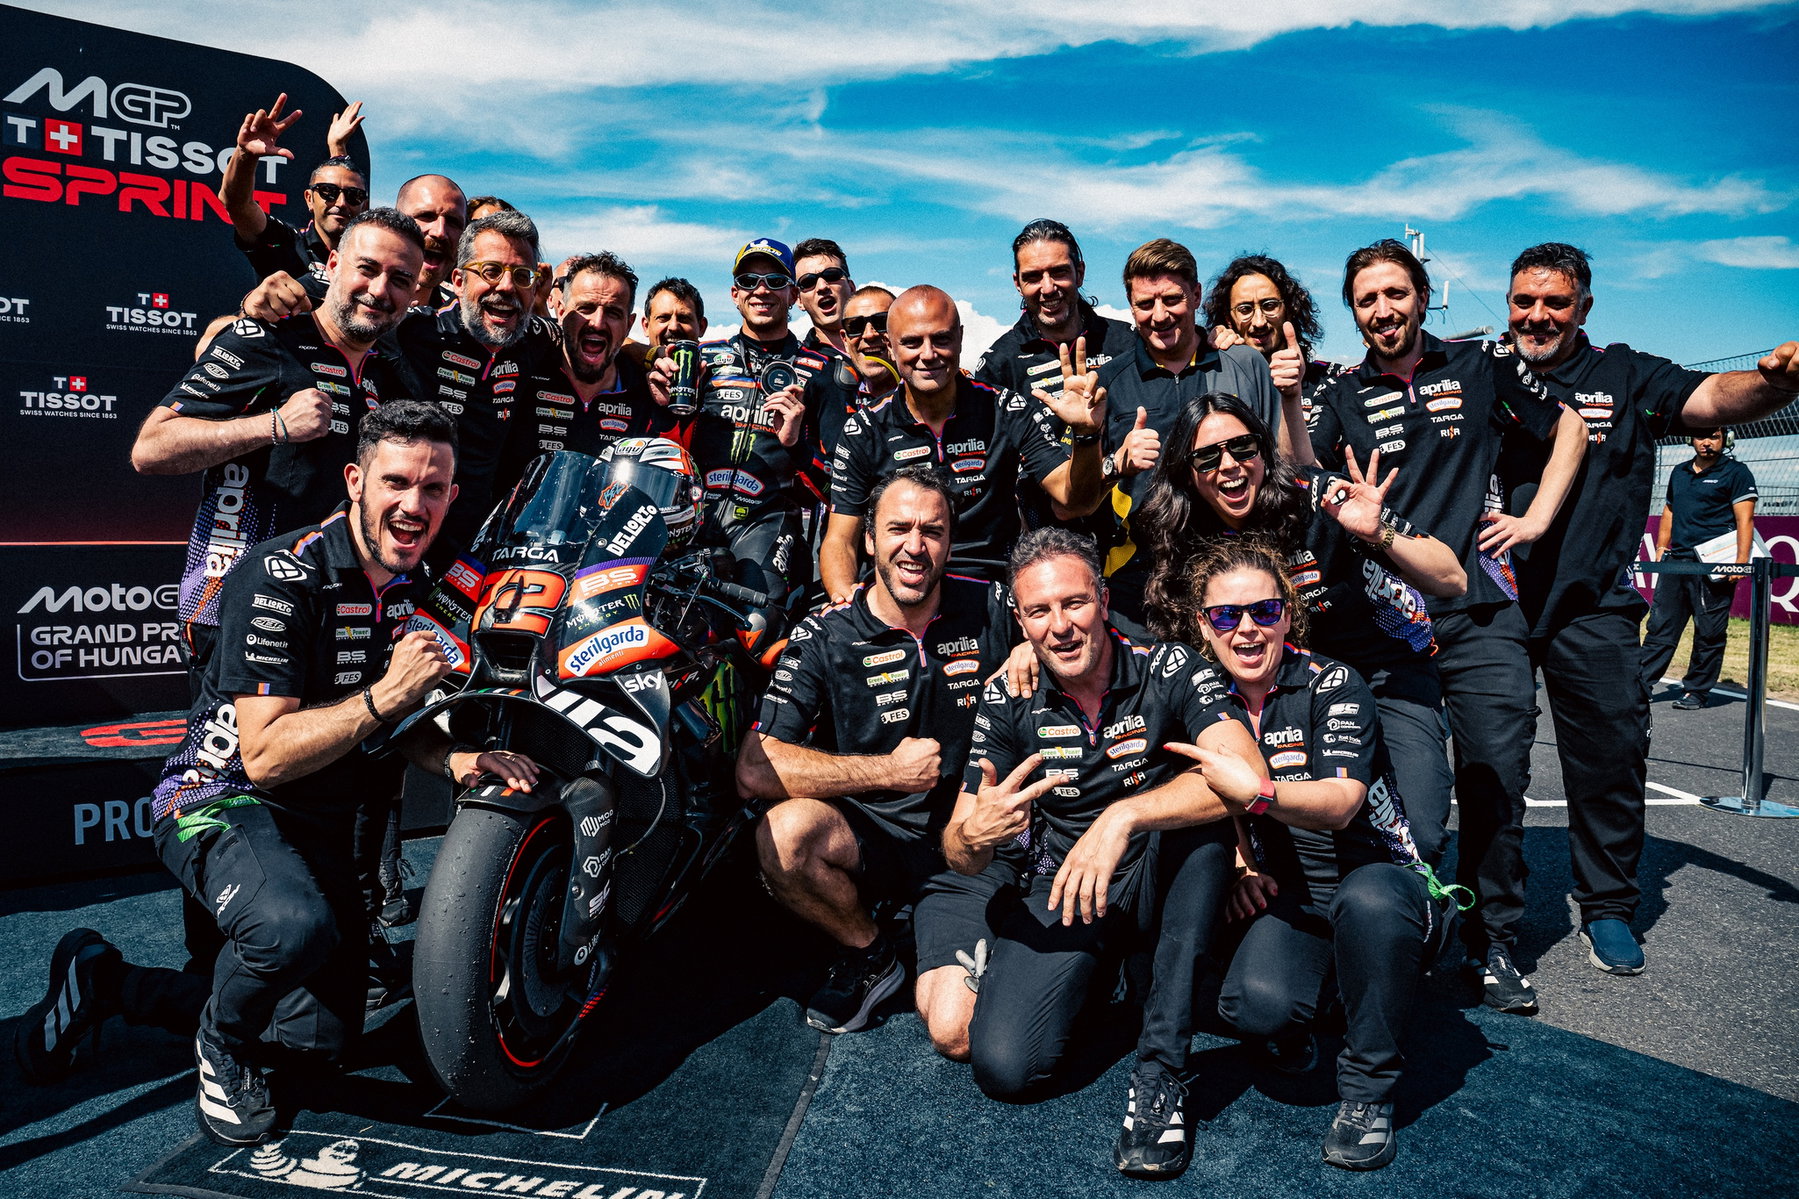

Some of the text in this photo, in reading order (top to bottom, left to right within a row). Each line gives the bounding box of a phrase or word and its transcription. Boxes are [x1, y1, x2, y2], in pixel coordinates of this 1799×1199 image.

[13, 316, 30, 324] 1853
[106, 306, 197, 328] TISSOT
[451, 354, 480, 369] Castrol
[1086, 353, 1113, 368] prilia
[320, 365, 345, 375] Castrol
[724, 390, 741, 398] FES
[1420, 379, 1461, 397] aprilia
[20, 391, 117, 411] TISSOT
[545, 394, 573, 403] Castrol
[1574, 391, 1614, 405] aprilia
[598, 403, 632, 417] aprilia
[1430, 413, 1464, 423] TARGA
[334, 422, 348, 432] FES
[539, 424, 567, 434] BS
[1375, 424, 1404, 437] BS
[546, 442, 562, 450] FES
[902, 447, 929, 458] Castrol
[946, 438, 985, 455] aprilia
[1387, 442, 1404, 451] FES
[491, 546, 559, 563] TARGA
[448, 563, 480, 589] BS
[580, 568, 638, 594] BS
[17, 583, 180, 614] MotoG
[1300, 586, 1329, 601] ARGA
[340, 605, 370, 614] Castrol
[31, 622, 180, 645] GRAND PR
[570, 626, 644, 672] sterilgarda
[937, 636, 979, 657] aprilia
[950, 649, 980, 658] RACING
[31, 645, 182, 670] OF HUNGA
[337, 650, 367, 662] BS
[598, 650, 625, 667] alimenti
[872, 651, 904, 664] Castrol
[946, 662, 977, 674] sterilgarda
[342, 673, 360, 682] FES
[624, 671, 663, 693] sky
[868, 676, 883, 684] Green
[947, 679, 980, 690] TARGA
[875, 689, 908, 704] BS
[890, 710, 908, 721] FES
[1047, 727, 1080, 737] Castrol
[1103, 714, 1145, 739] aprilia
[1114, 726, 1147, 740] RACING
[1264, 726, 1304, 747] aprilia
[1109, 741, 1145, 756] sterilgarda
[1111, 758, 1149, 772] TARGA
[1271, 752, 1305, 765] sterilgarda
[1274, 772, 1312, 782] TARGA
